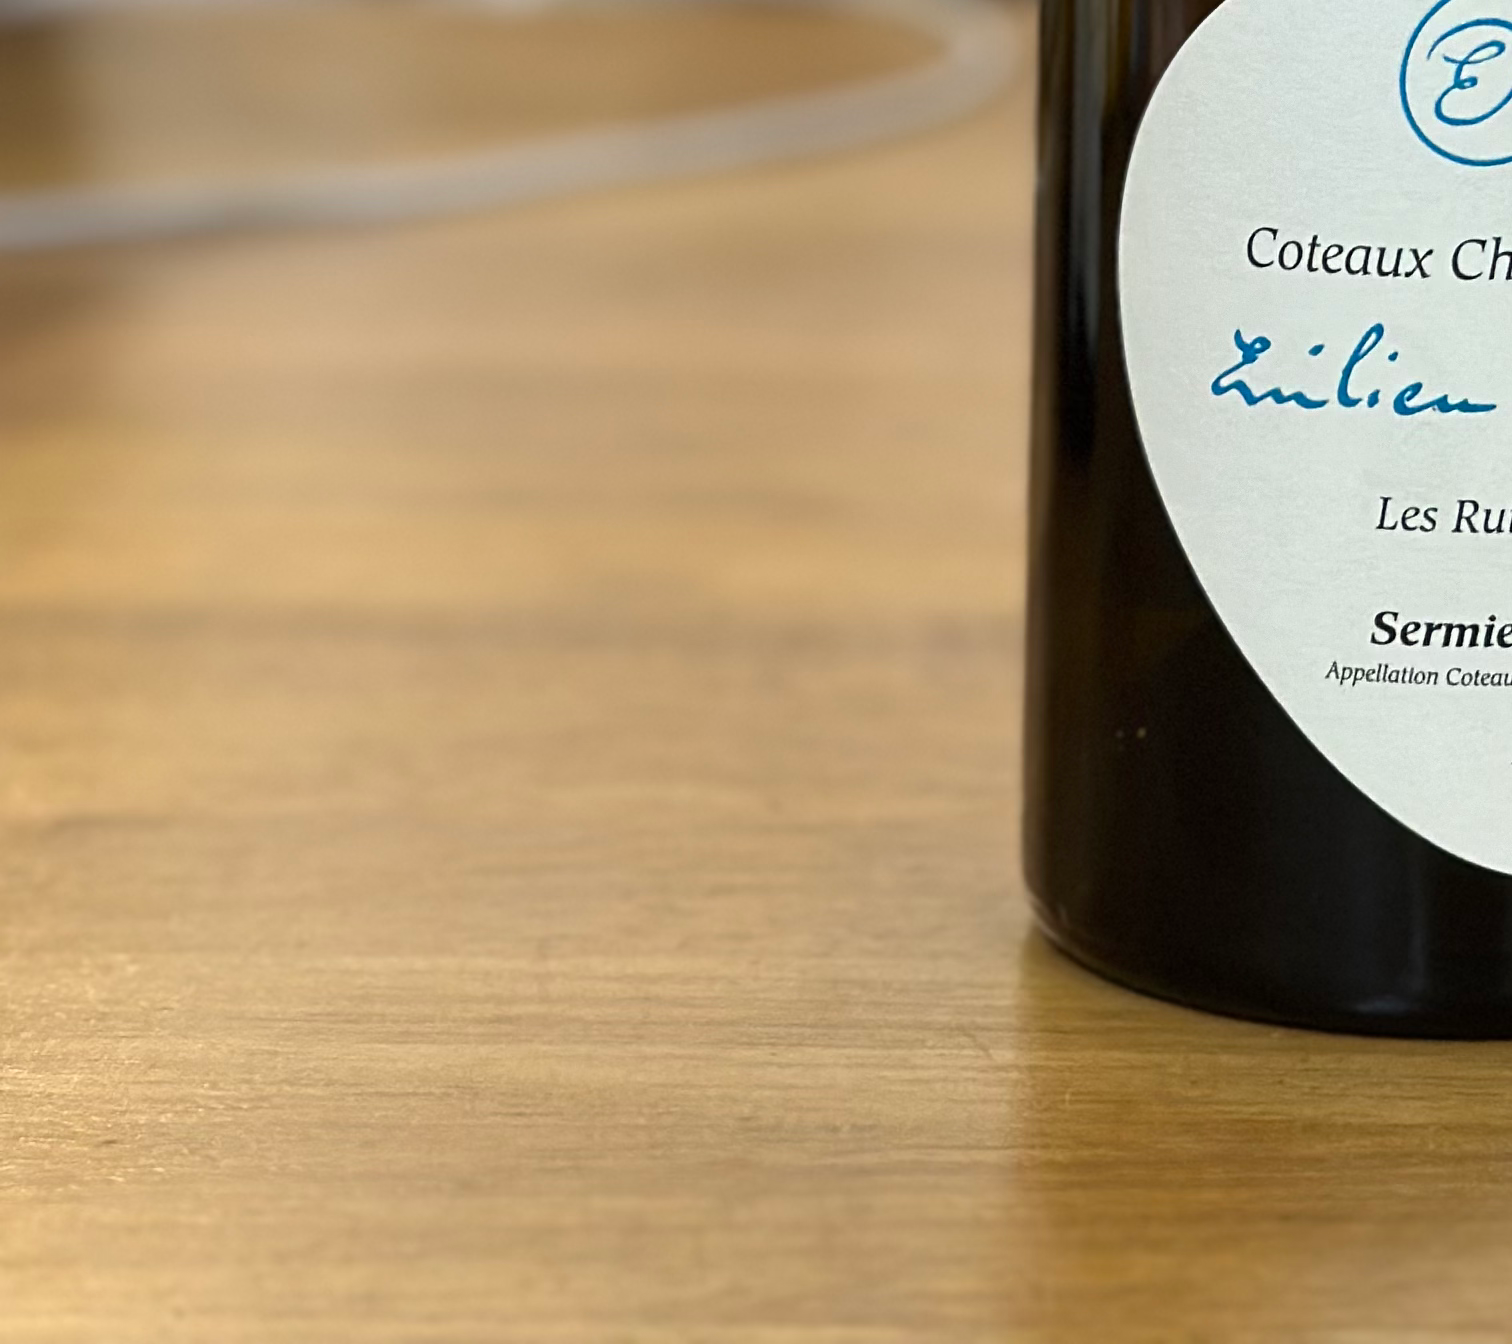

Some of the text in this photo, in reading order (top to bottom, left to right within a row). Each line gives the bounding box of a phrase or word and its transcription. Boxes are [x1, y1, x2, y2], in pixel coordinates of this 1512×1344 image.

[1245, 225, 1436, 281] Coteaux
[1374, 495, 1440, 534] Les
[1323, 659, 1440, 687] Appellation
